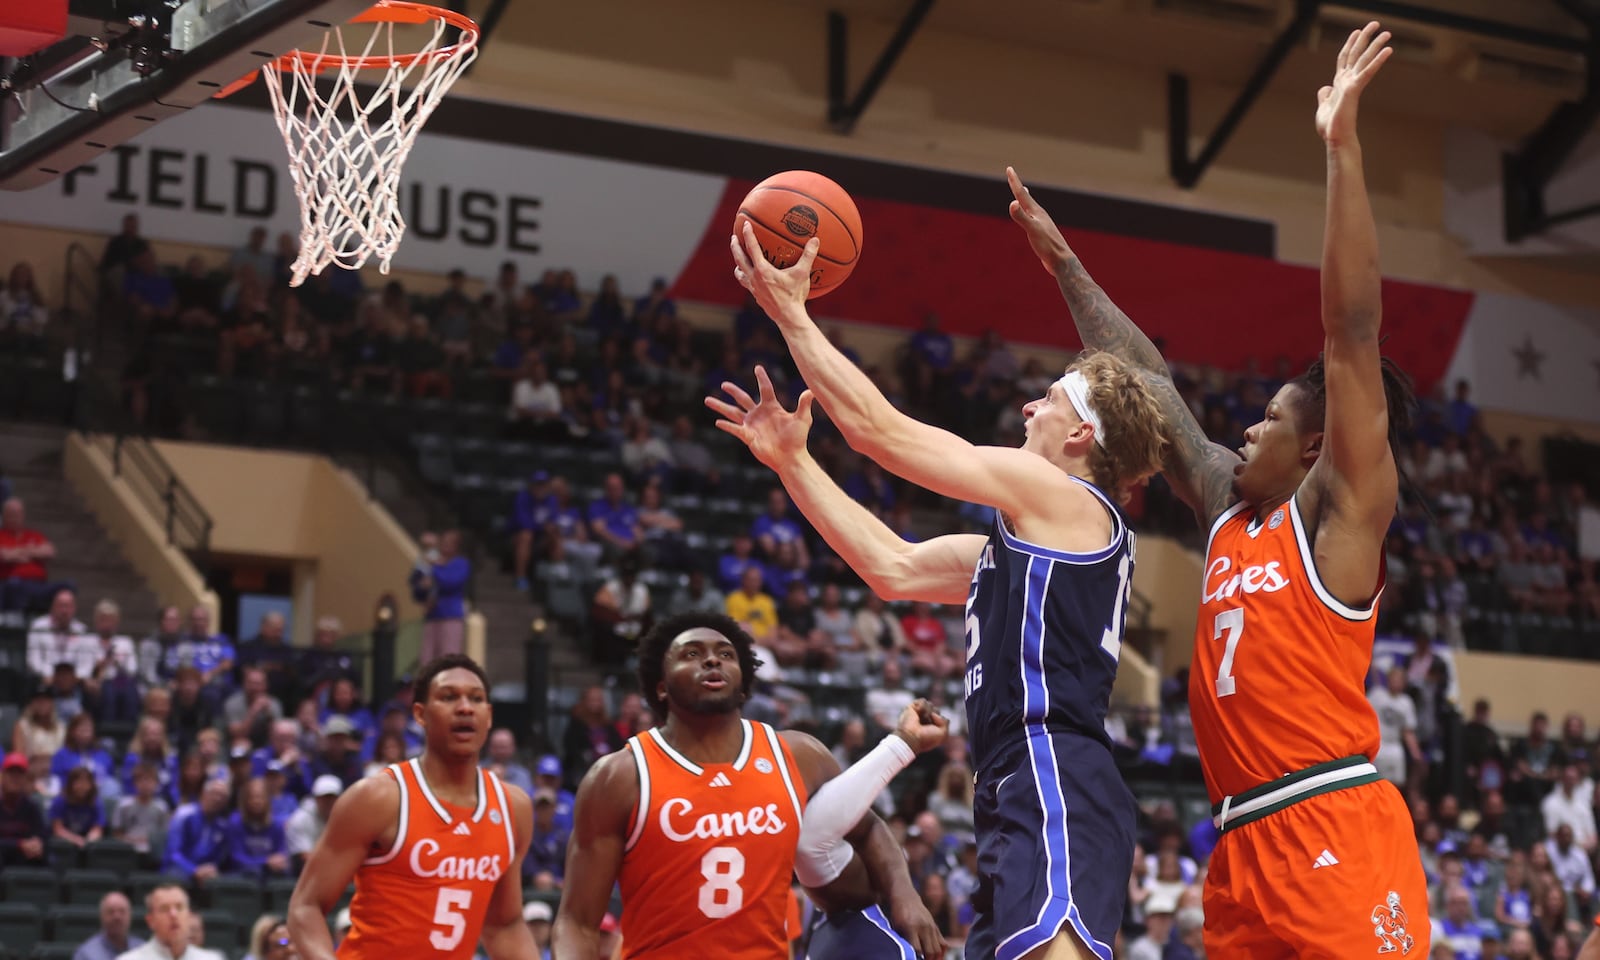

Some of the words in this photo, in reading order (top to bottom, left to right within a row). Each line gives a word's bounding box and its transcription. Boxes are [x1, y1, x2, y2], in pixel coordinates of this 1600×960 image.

[318, 172, 542, 255] USE
[1213, 607, 1245, 698] 7
[659, 797, 787, 842] Canes
[408, 837, 501, 882] Canes
[697, 846, 746, 919] 8
[428, 887, 473, 952] 5
